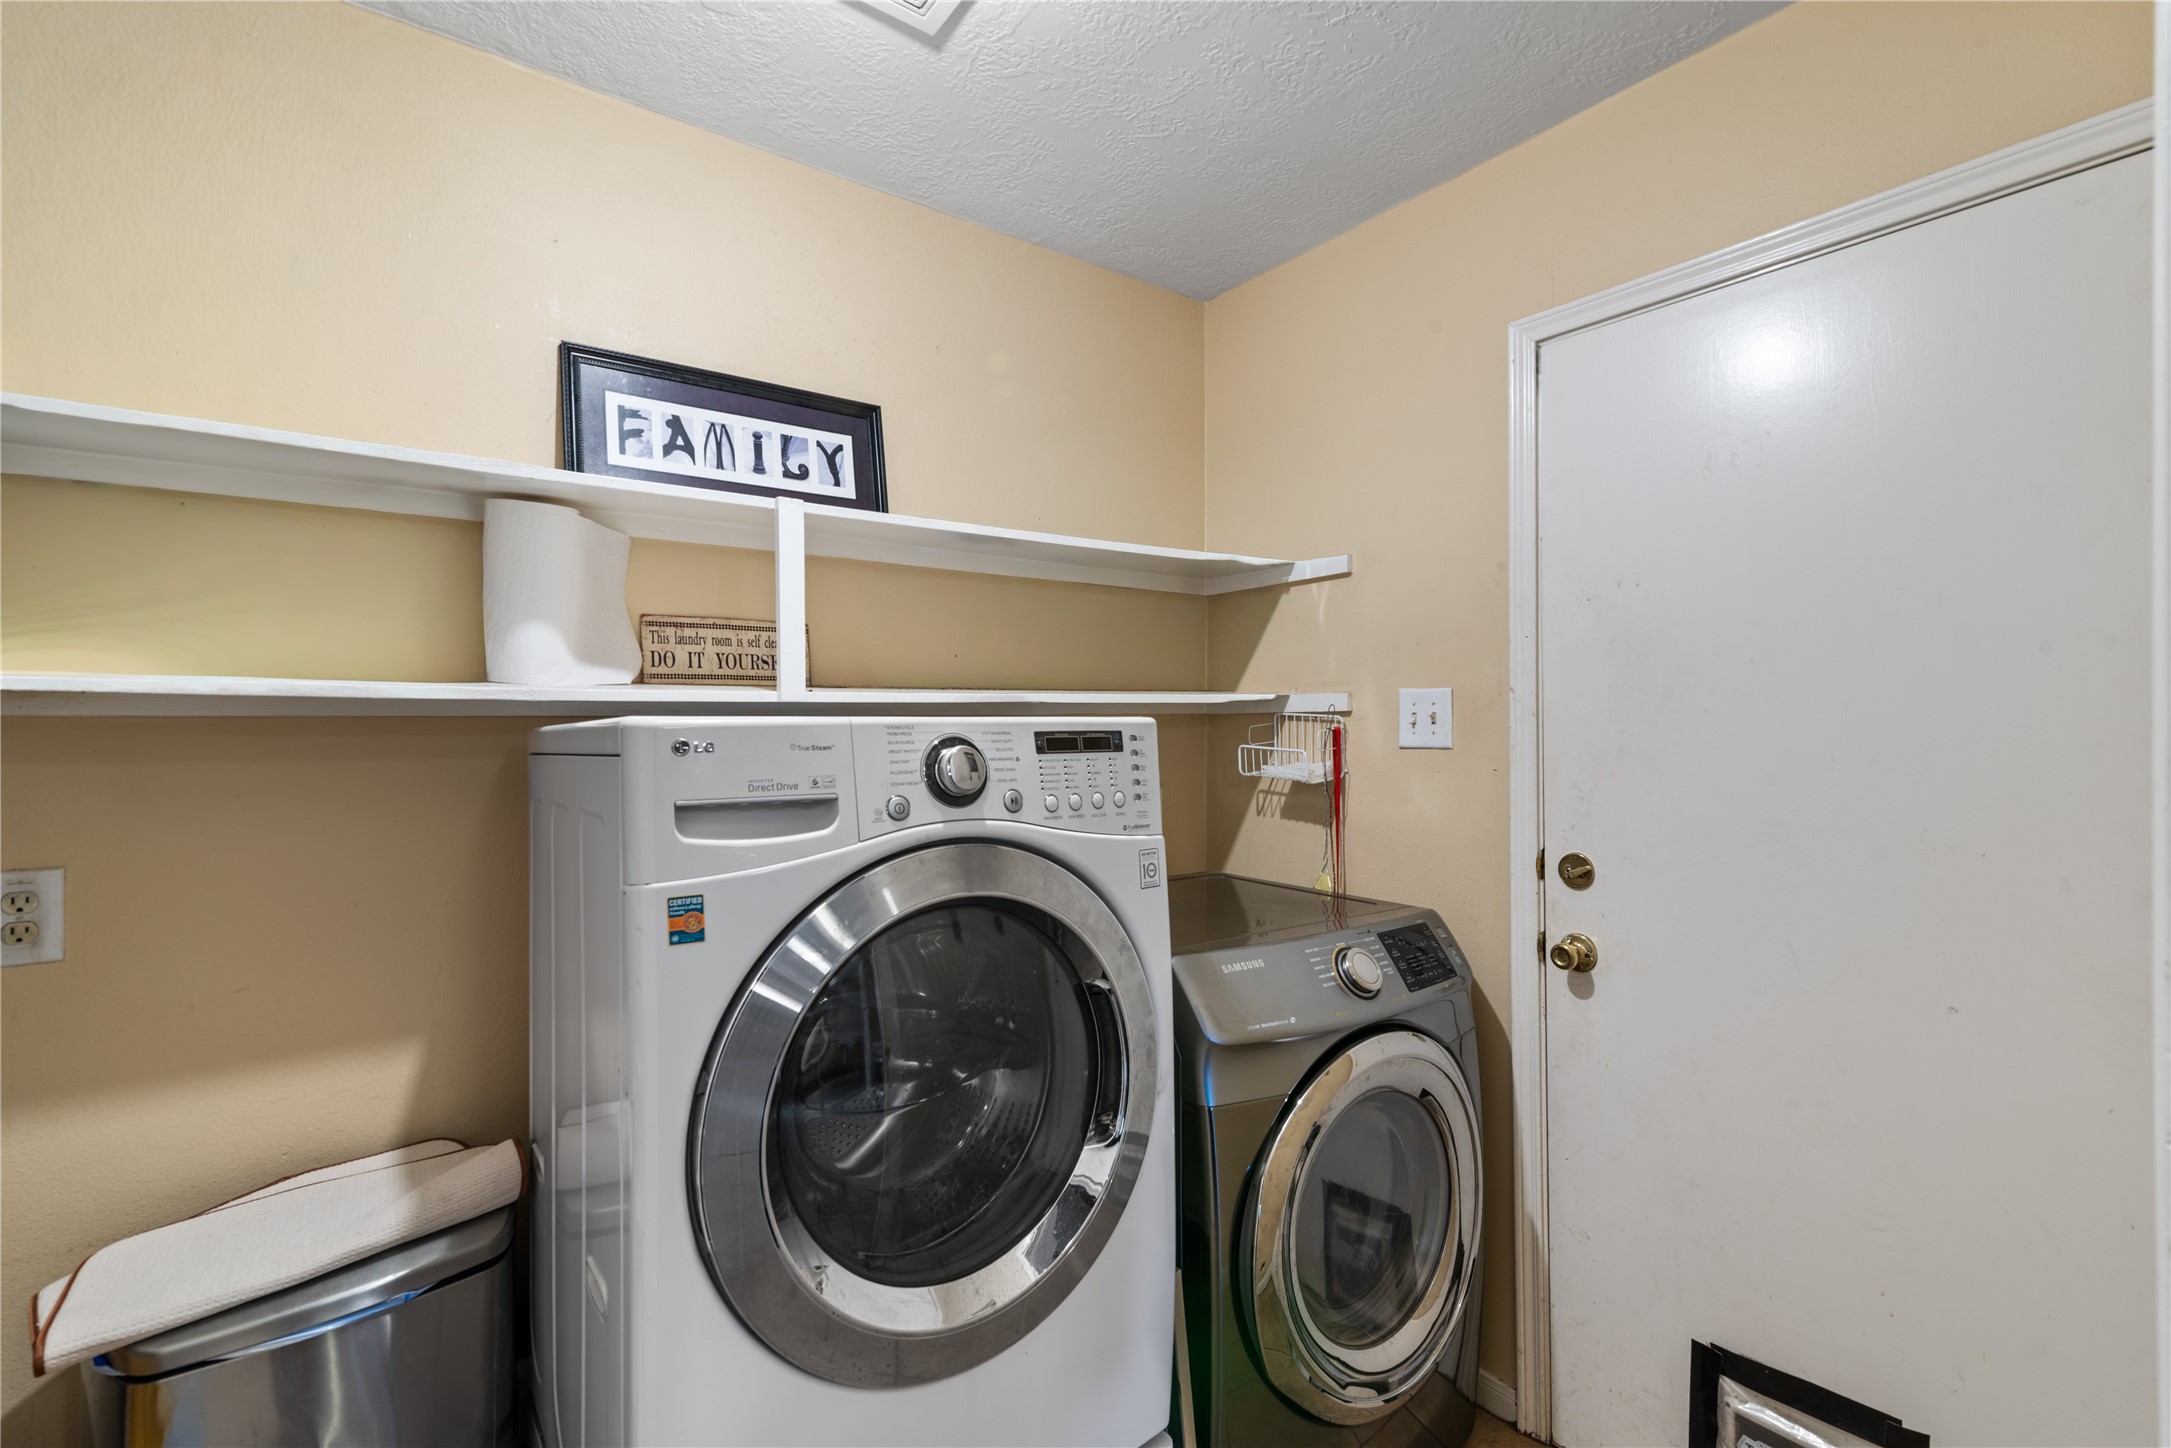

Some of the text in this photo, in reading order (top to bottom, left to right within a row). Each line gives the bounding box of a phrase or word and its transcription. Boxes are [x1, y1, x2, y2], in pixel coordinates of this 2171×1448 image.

[617, 404, 845, 488] FAMILY
[649, 630, 670, 645] This
[674, 630, 707, 650] laundry
[711, 636, 733, 647] room
[736, 633, 743, 647] is
[747, 634, 761, 648] self
[650, 650, 676, 668] DO
[687, 651, 705, 669] IT
[693, 740, 715, 753] LG
[748, 782, 799, 793] Direct Drive
[669, 896, 702, 906] CERTIFIED
[1221, 958, 1265, 974] SAMSUNG
